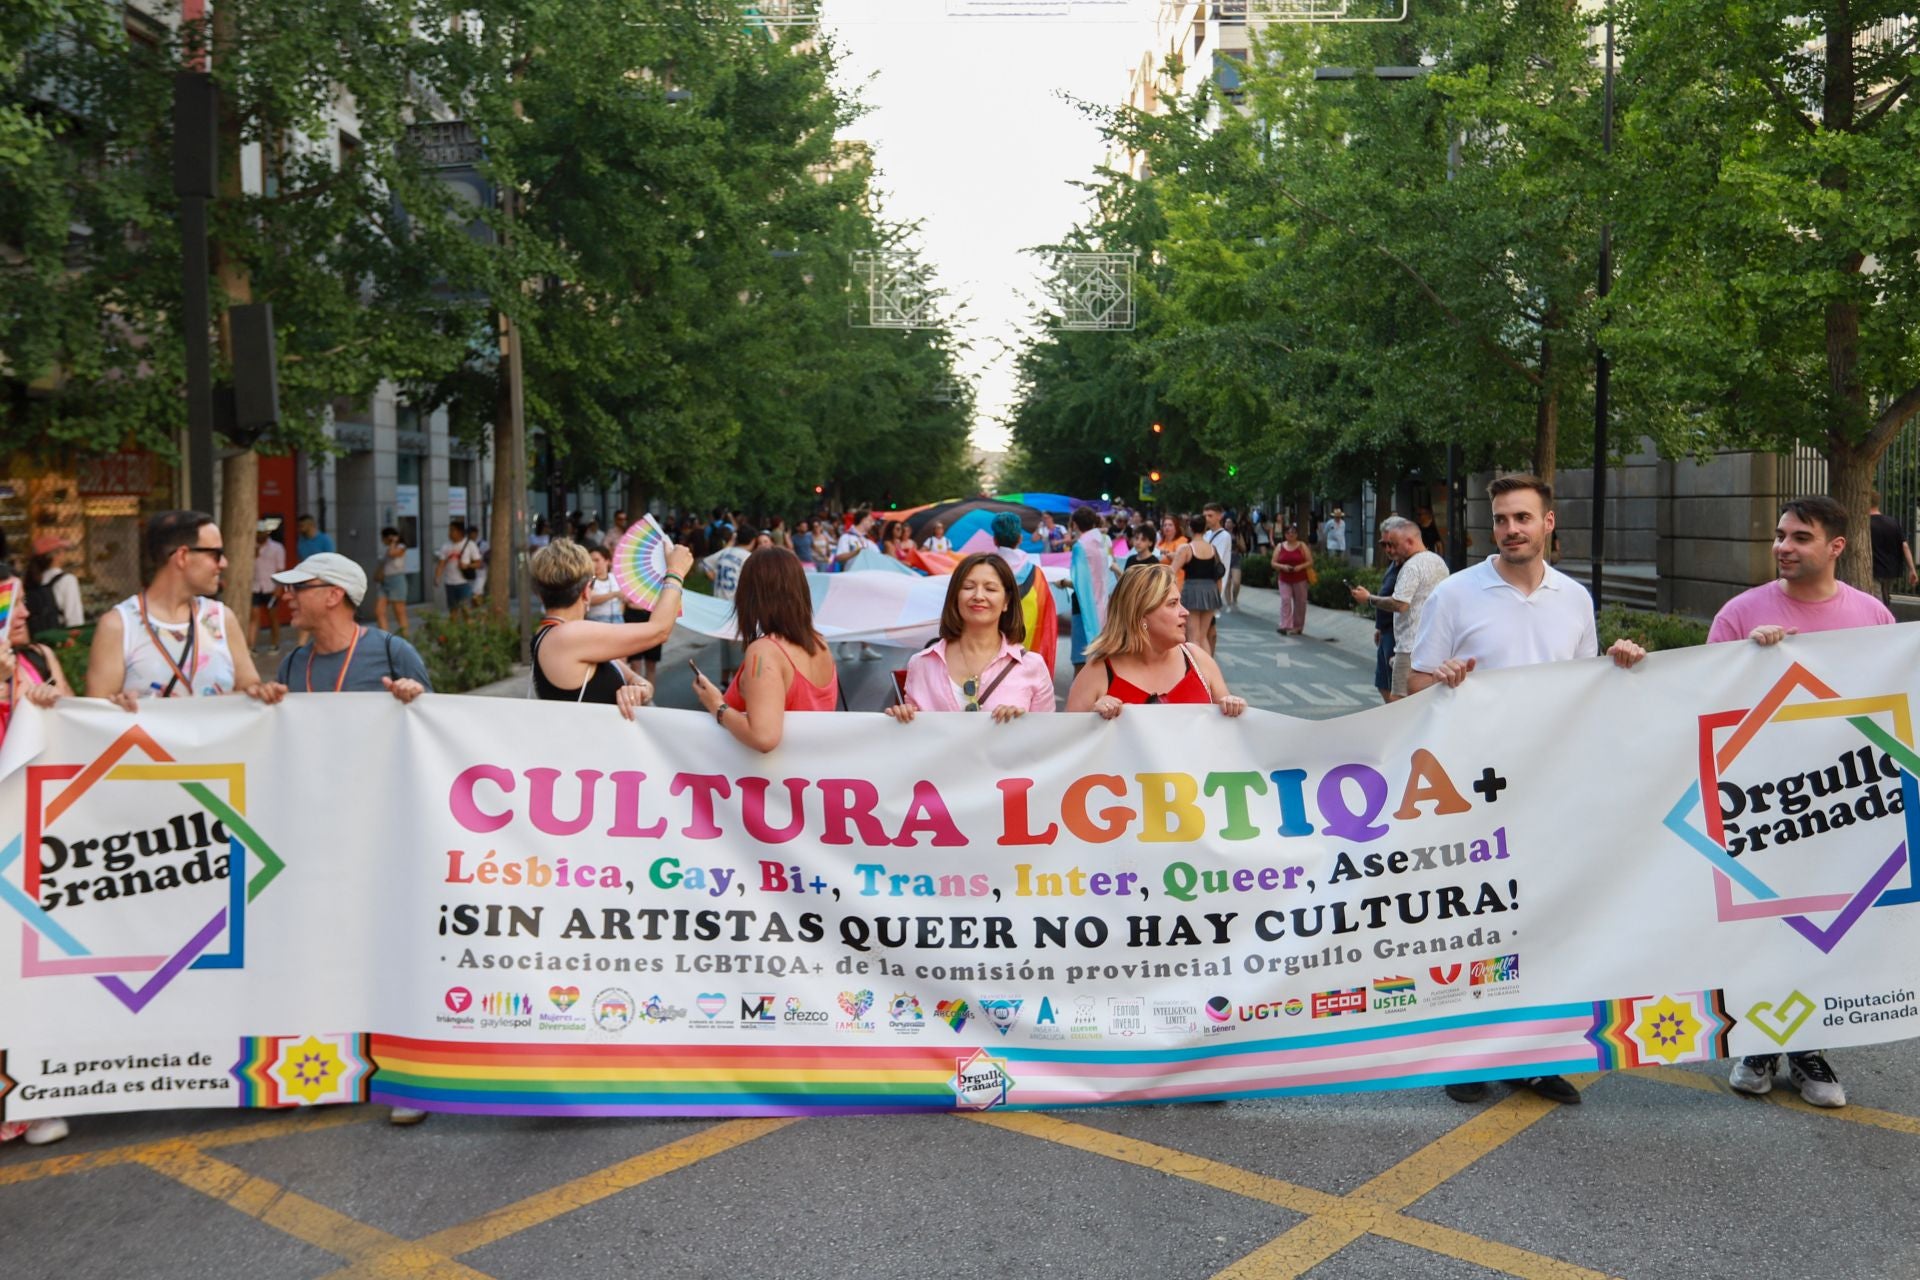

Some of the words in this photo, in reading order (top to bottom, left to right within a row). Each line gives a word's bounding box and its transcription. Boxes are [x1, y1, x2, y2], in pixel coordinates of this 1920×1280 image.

[448, 764, 970, 848] CULTURA
[996, 748, 1507, 846] LGBTIQA+
[444, 849, 634, 895] Lésbica,
[648, 857, 745, 898] Gay,
[759, 860, 841, 902] Bi+,
[853, 863, 1002, 902] Trans,
[1014, 863, 1149, 902] Inter,
[1163, 861, 1316, 902] Queer,
[1327, 827, 1510, 886] Asexual
[438, 904, 544, 938] ¡SIN
[559, 908, 824, 943] ARTISTAS
[839, 915, 1017, 952] QUEER
[1033, 914, 1109, 949] NO
[1127, 912, 1238, 949] HAY
[1254, 879, 1520, 942] CULTURA!
[457, 948, 664, 974] Asociaciones
[676, 953, 824, 978] LGBTIQA+
[835, 956, 870, 976] de
[880, 958, 905, 978] la
[915, 957, 1055, 982] comisión
[1065, 955, 1232, 985] provincial
[1243, 944, 1362, 977] Orgullo
[1373, 926, 1501, 960] Granada
[1373, 993, 1417, 1010] USTEA
[1824, 989, 1915, 1011] Diputación
[538, 1022, 586, 1031] Diversidad
[783, 1011, 829, 1021] crezco
[1823, 1012, 1844, 1027] de
[1848, 1004, 1919, 1025] Granada
[41, 1059, 67, 1075] La
[74, 1053, 181, 1075] provincia
[187, 1052, 212, 1066] de
[20, 1079, 117, 1101] Granada
[123, 1080, 145, 1093] es
[151, 1076, 230, 1091] diversa
